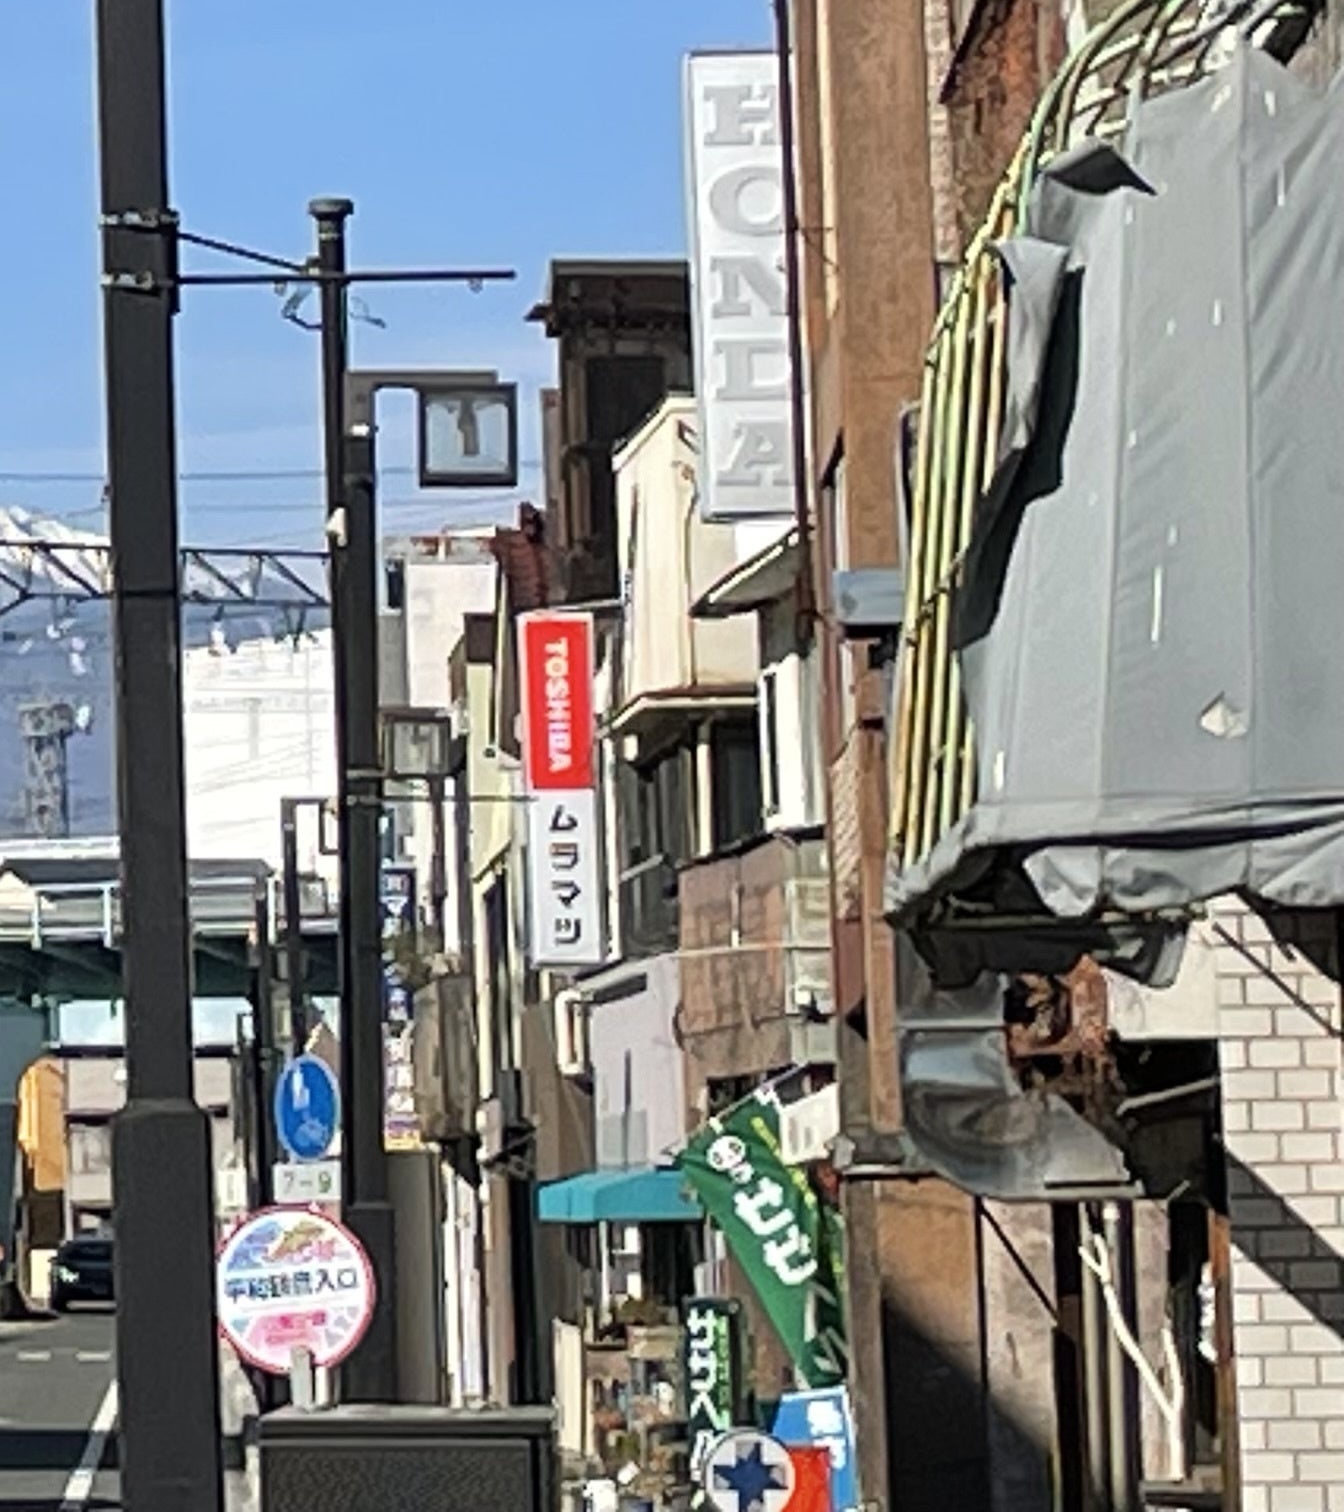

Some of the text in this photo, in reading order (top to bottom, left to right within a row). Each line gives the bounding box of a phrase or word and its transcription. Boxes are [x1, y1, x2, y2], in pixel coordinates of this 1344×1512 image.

[703, 85, 790, 486] HONDA
[544, 636, 573, 773] TOSHIBA
[548, 804, 582, 948] ムラマツ
